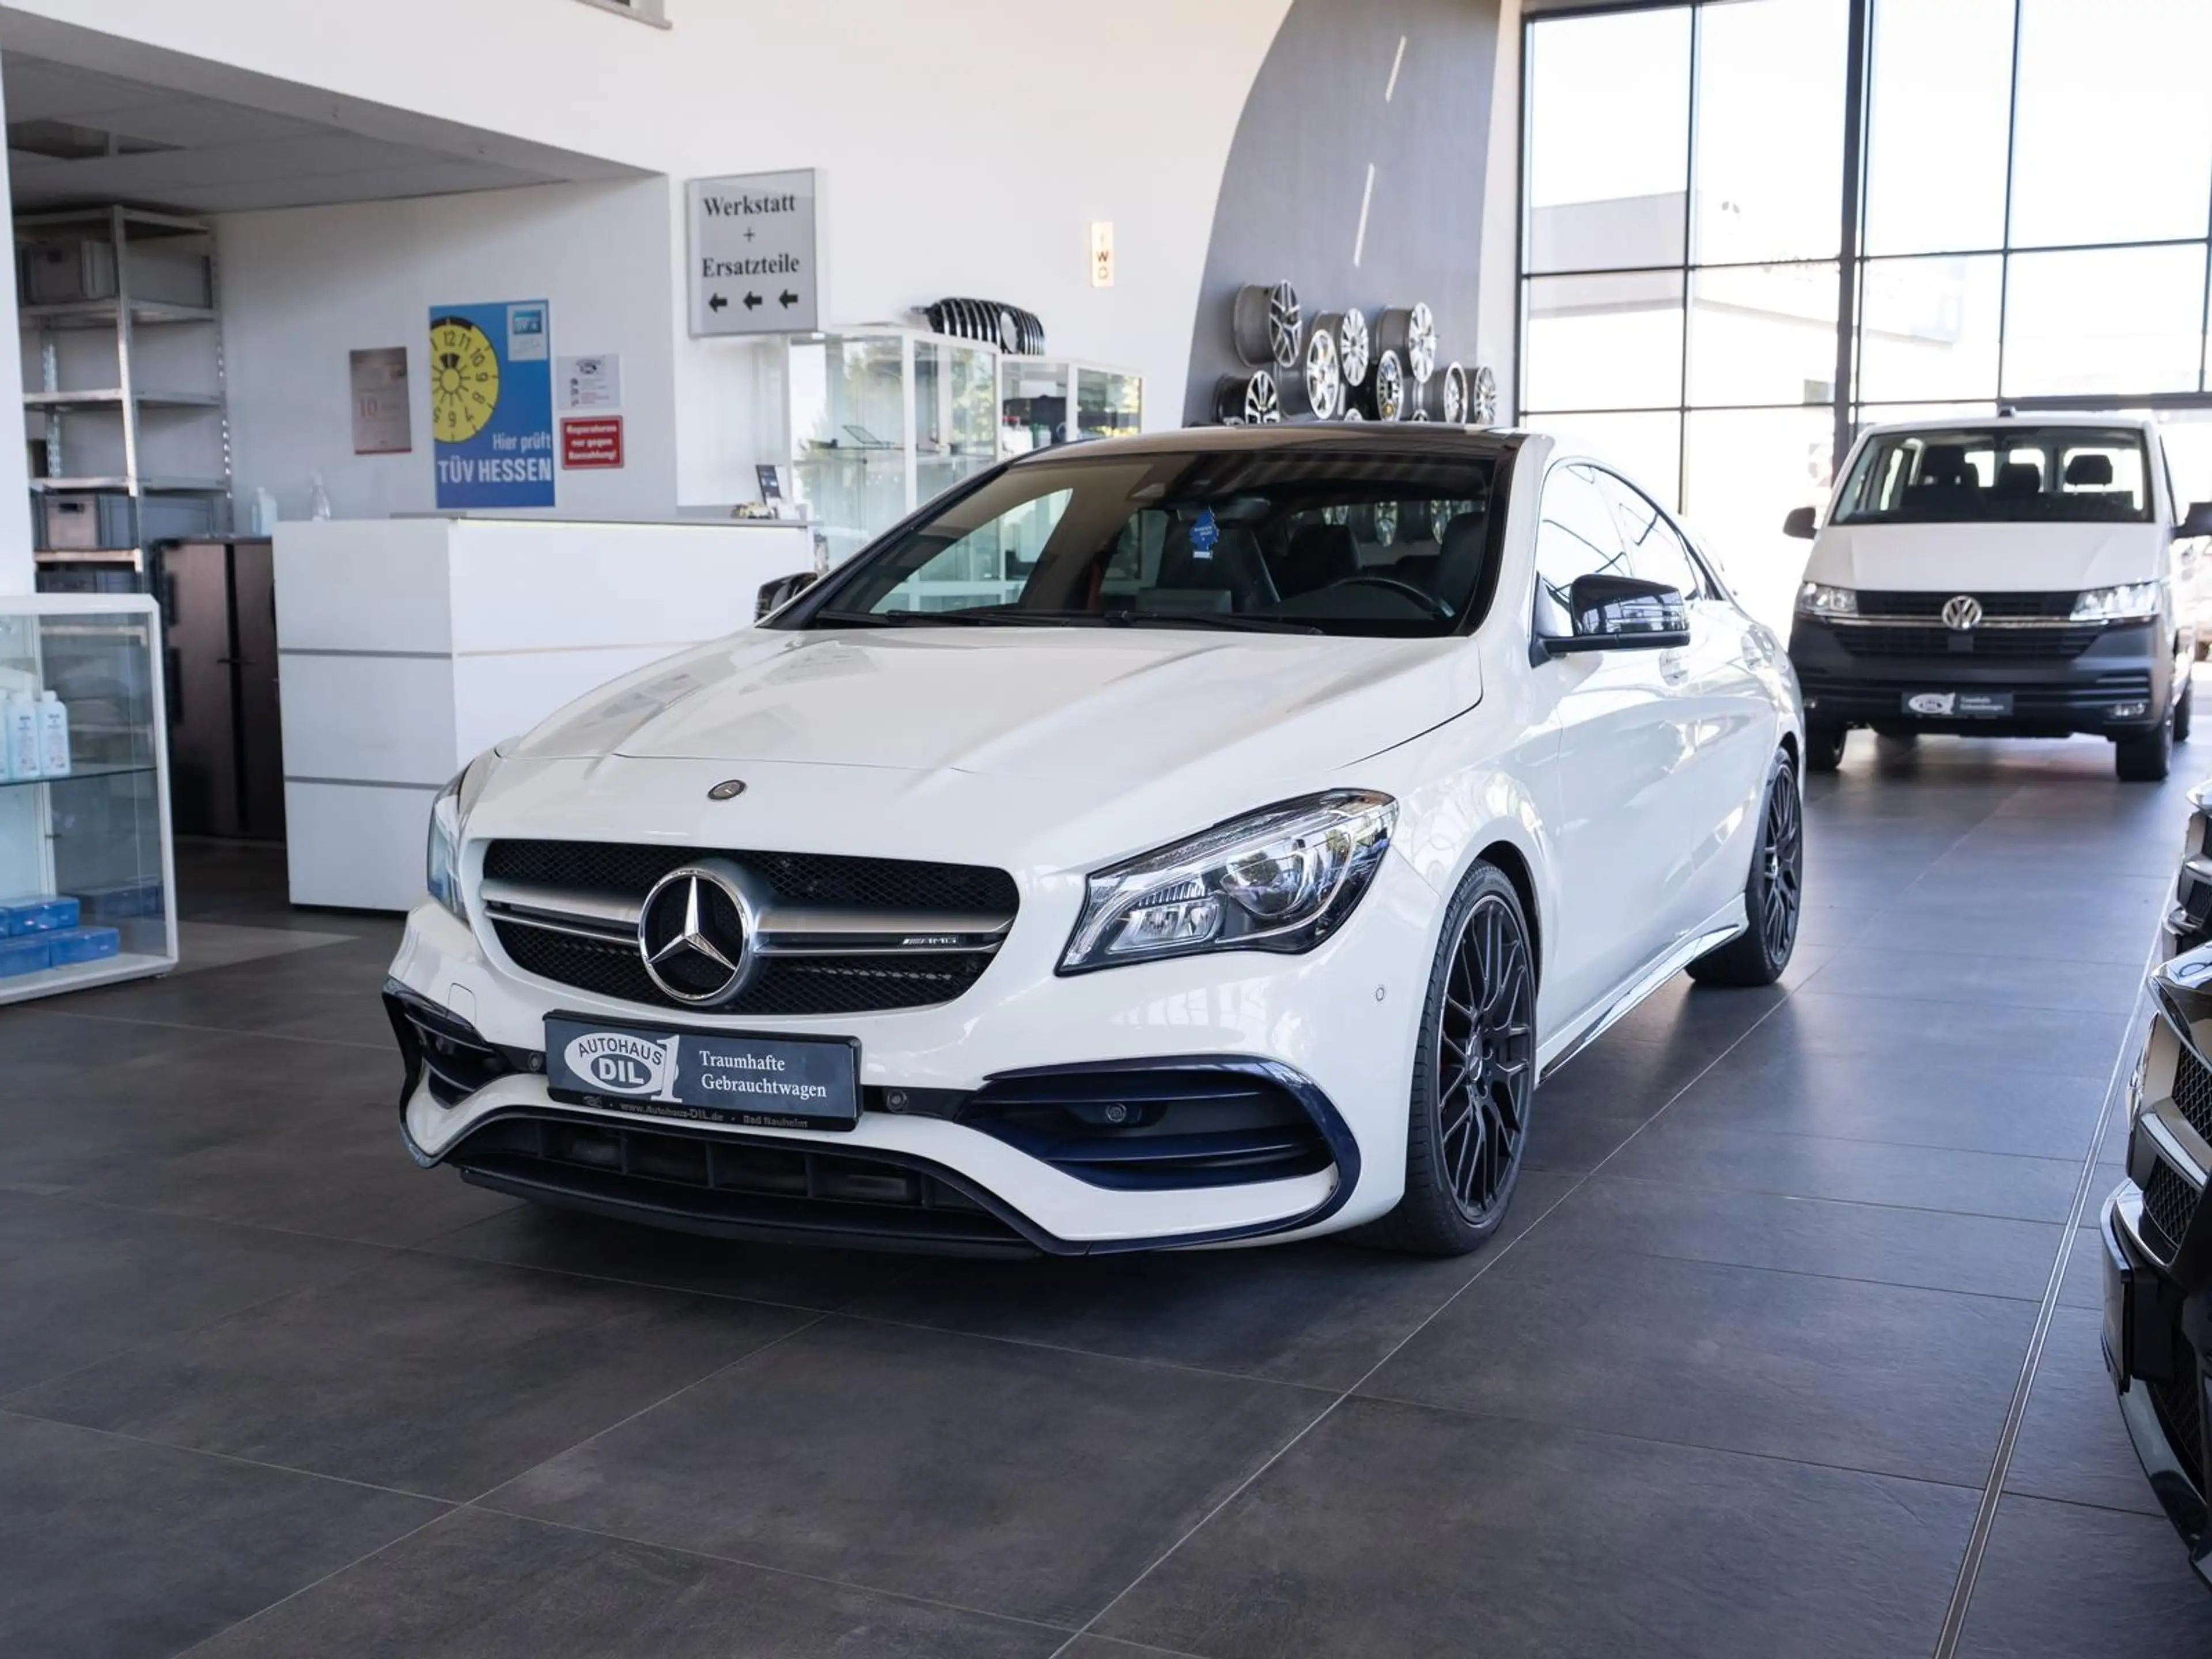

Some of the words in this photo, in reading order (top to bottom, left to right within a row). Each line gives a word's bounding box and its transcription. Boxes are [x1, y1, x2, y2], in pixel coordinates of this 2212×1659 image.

[702, 194, 796, 217] Werkstatt
[743, 227, 756, 243] +
[702, 252, 800, 278] Ersatzteile
[444, 330, 456, 347] 12
[459, 333, 472, 351] 11
[469, 348, 486, 367] 10
[493, 431, 517, 450] Hier
[521, 430, 551, 454] prüft
[437, 454, 475, 483] TÜV
[478, 458, 552, 483] HESSEN
[578, 1037, 663, 1066] AUTOHAUS
[699, 1050, 786, 1071] Traumhafte
[598, 1057, 645, 1085] DIL
[701, 1074, 827, 1100] Gebrauchtwagen
[619, 1101, 724, 1123] www.Autohaus-DIL.de
[743, 1115, 762, 1126] Bad
[764, 1116, 808, 1128] Nauheim
